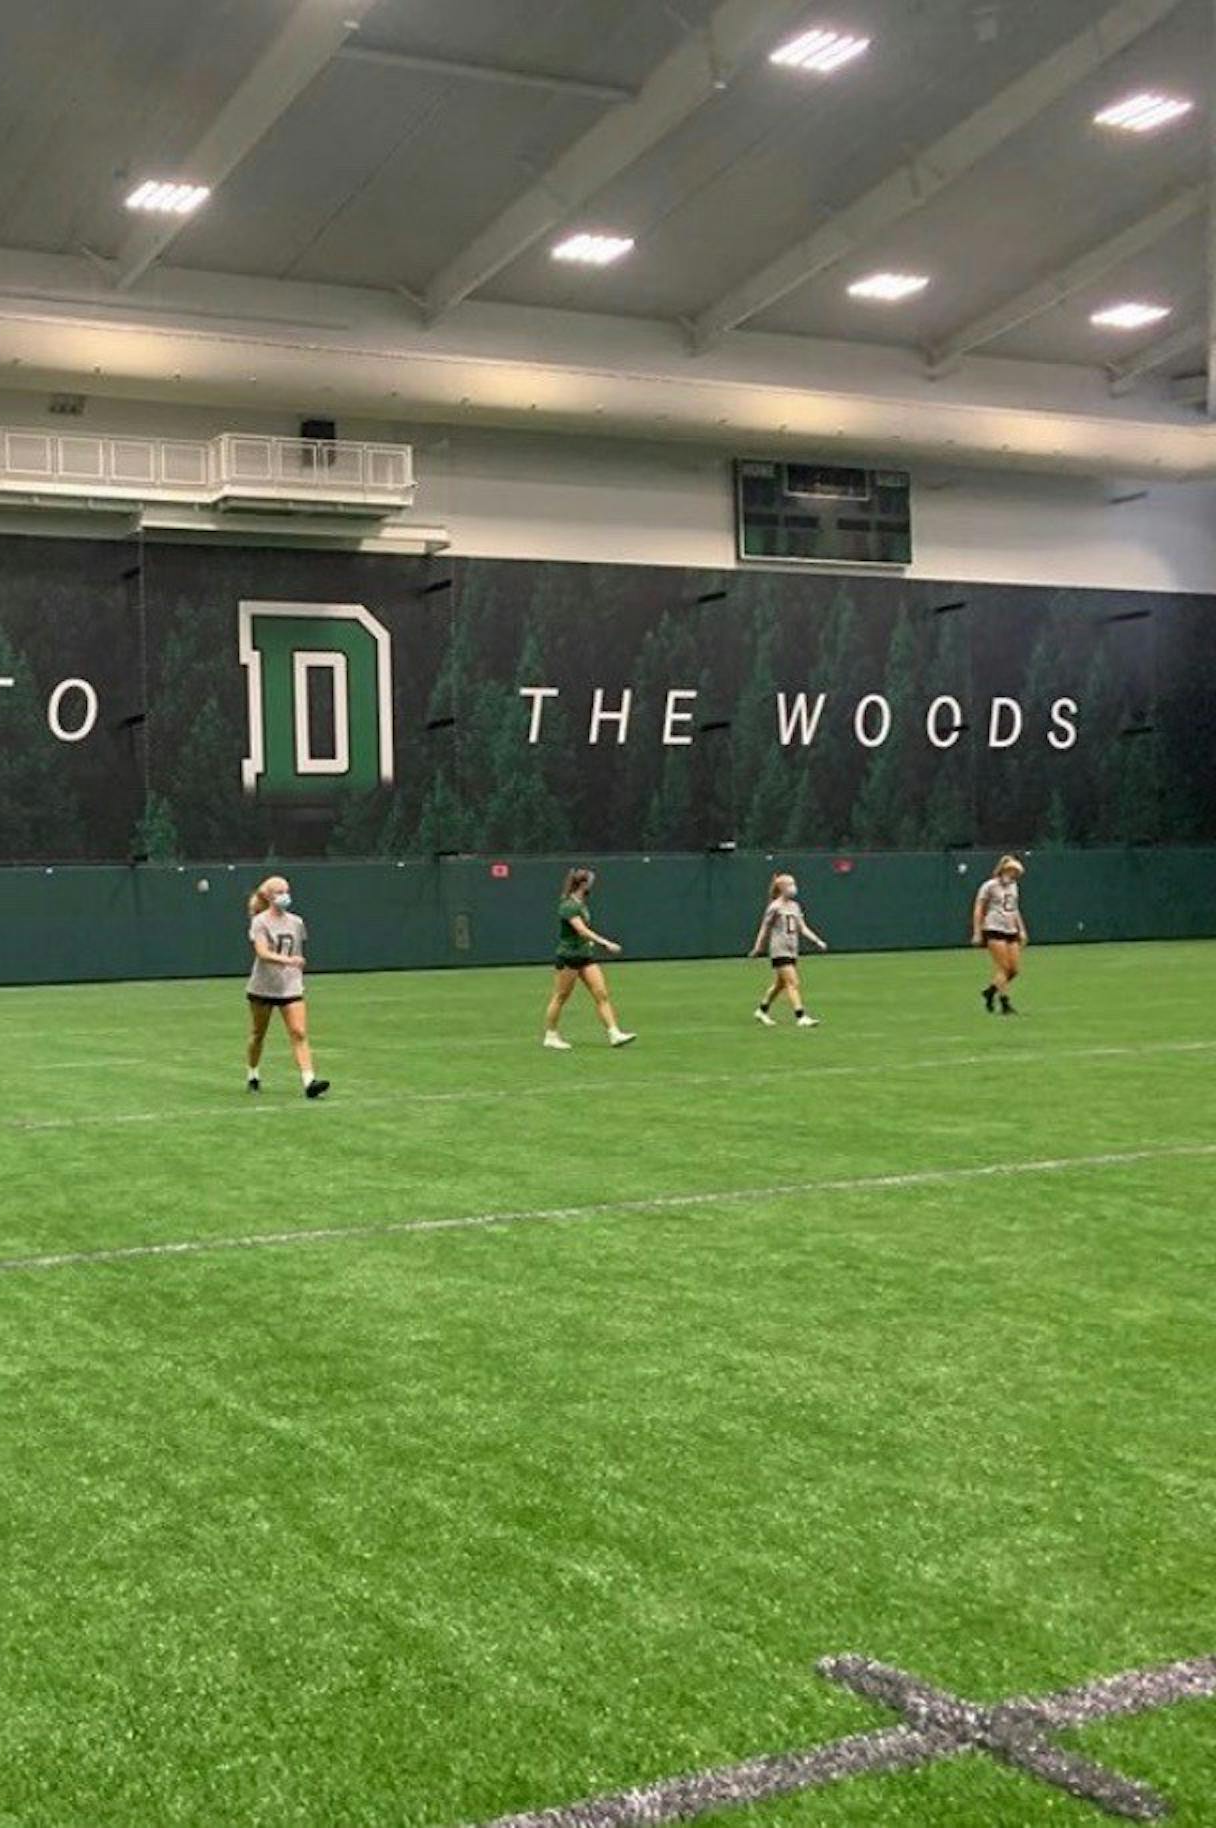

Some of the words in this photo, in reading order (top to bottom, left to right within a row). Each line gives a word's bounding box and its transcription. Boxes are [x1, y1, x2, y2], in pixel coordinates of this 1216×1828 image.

[239, 601, 393, 794] D
[518, 686, 698, 746] THE
[776, 692, 1080, 750] WOODS
